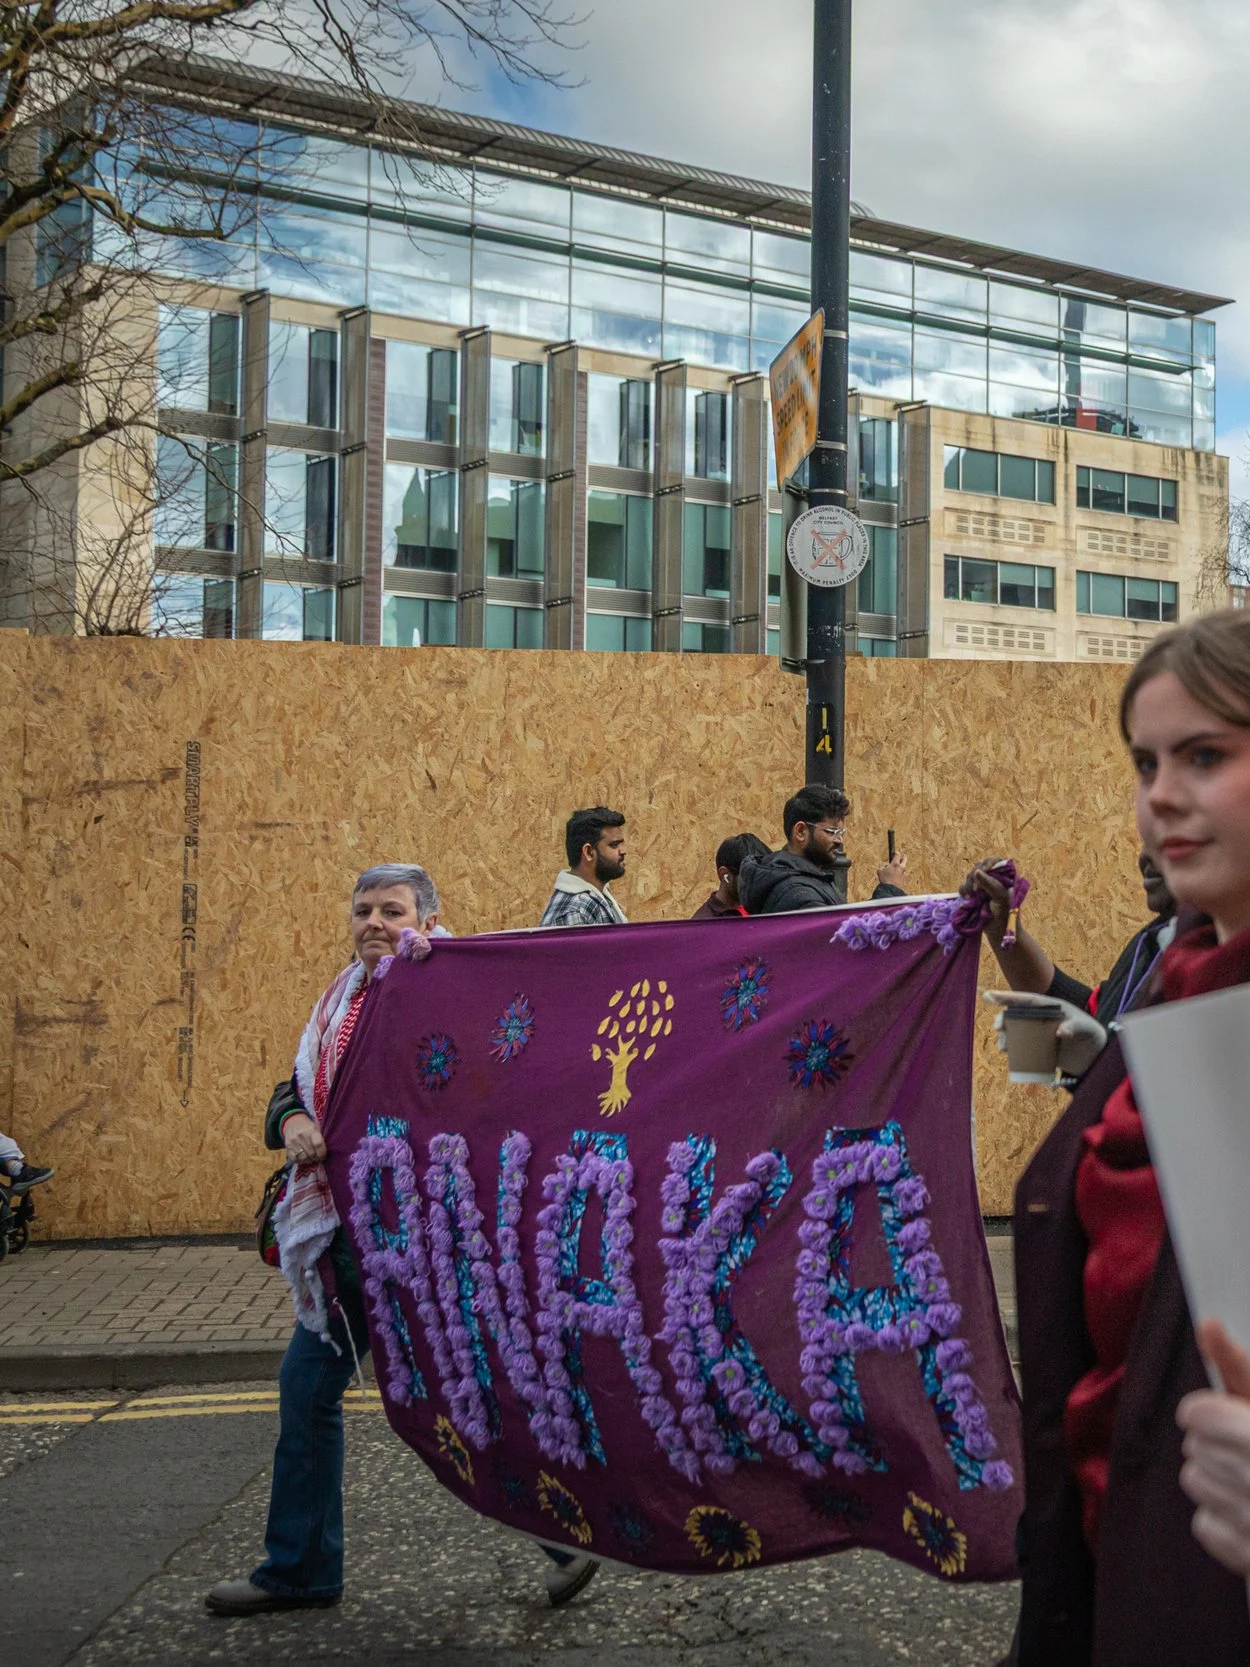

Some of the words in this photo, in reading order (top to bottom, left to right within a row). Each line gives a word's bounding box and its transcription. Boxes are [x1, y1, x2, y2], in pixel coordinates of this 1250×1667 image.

[800, 332, 817, 367] MPH
[776, 393, 795, 437] SPEED
[800, 511, 814, 523] DRINK
[813, 506, 835, 514] ALCOHOL
[840, 510, 857, 523] PUBLIC
[855, 521, 866, 538] PLACES
[799, 568, 821, 584] MAXIMUM
[349, 1110, 1014, 1492] ANAKA
